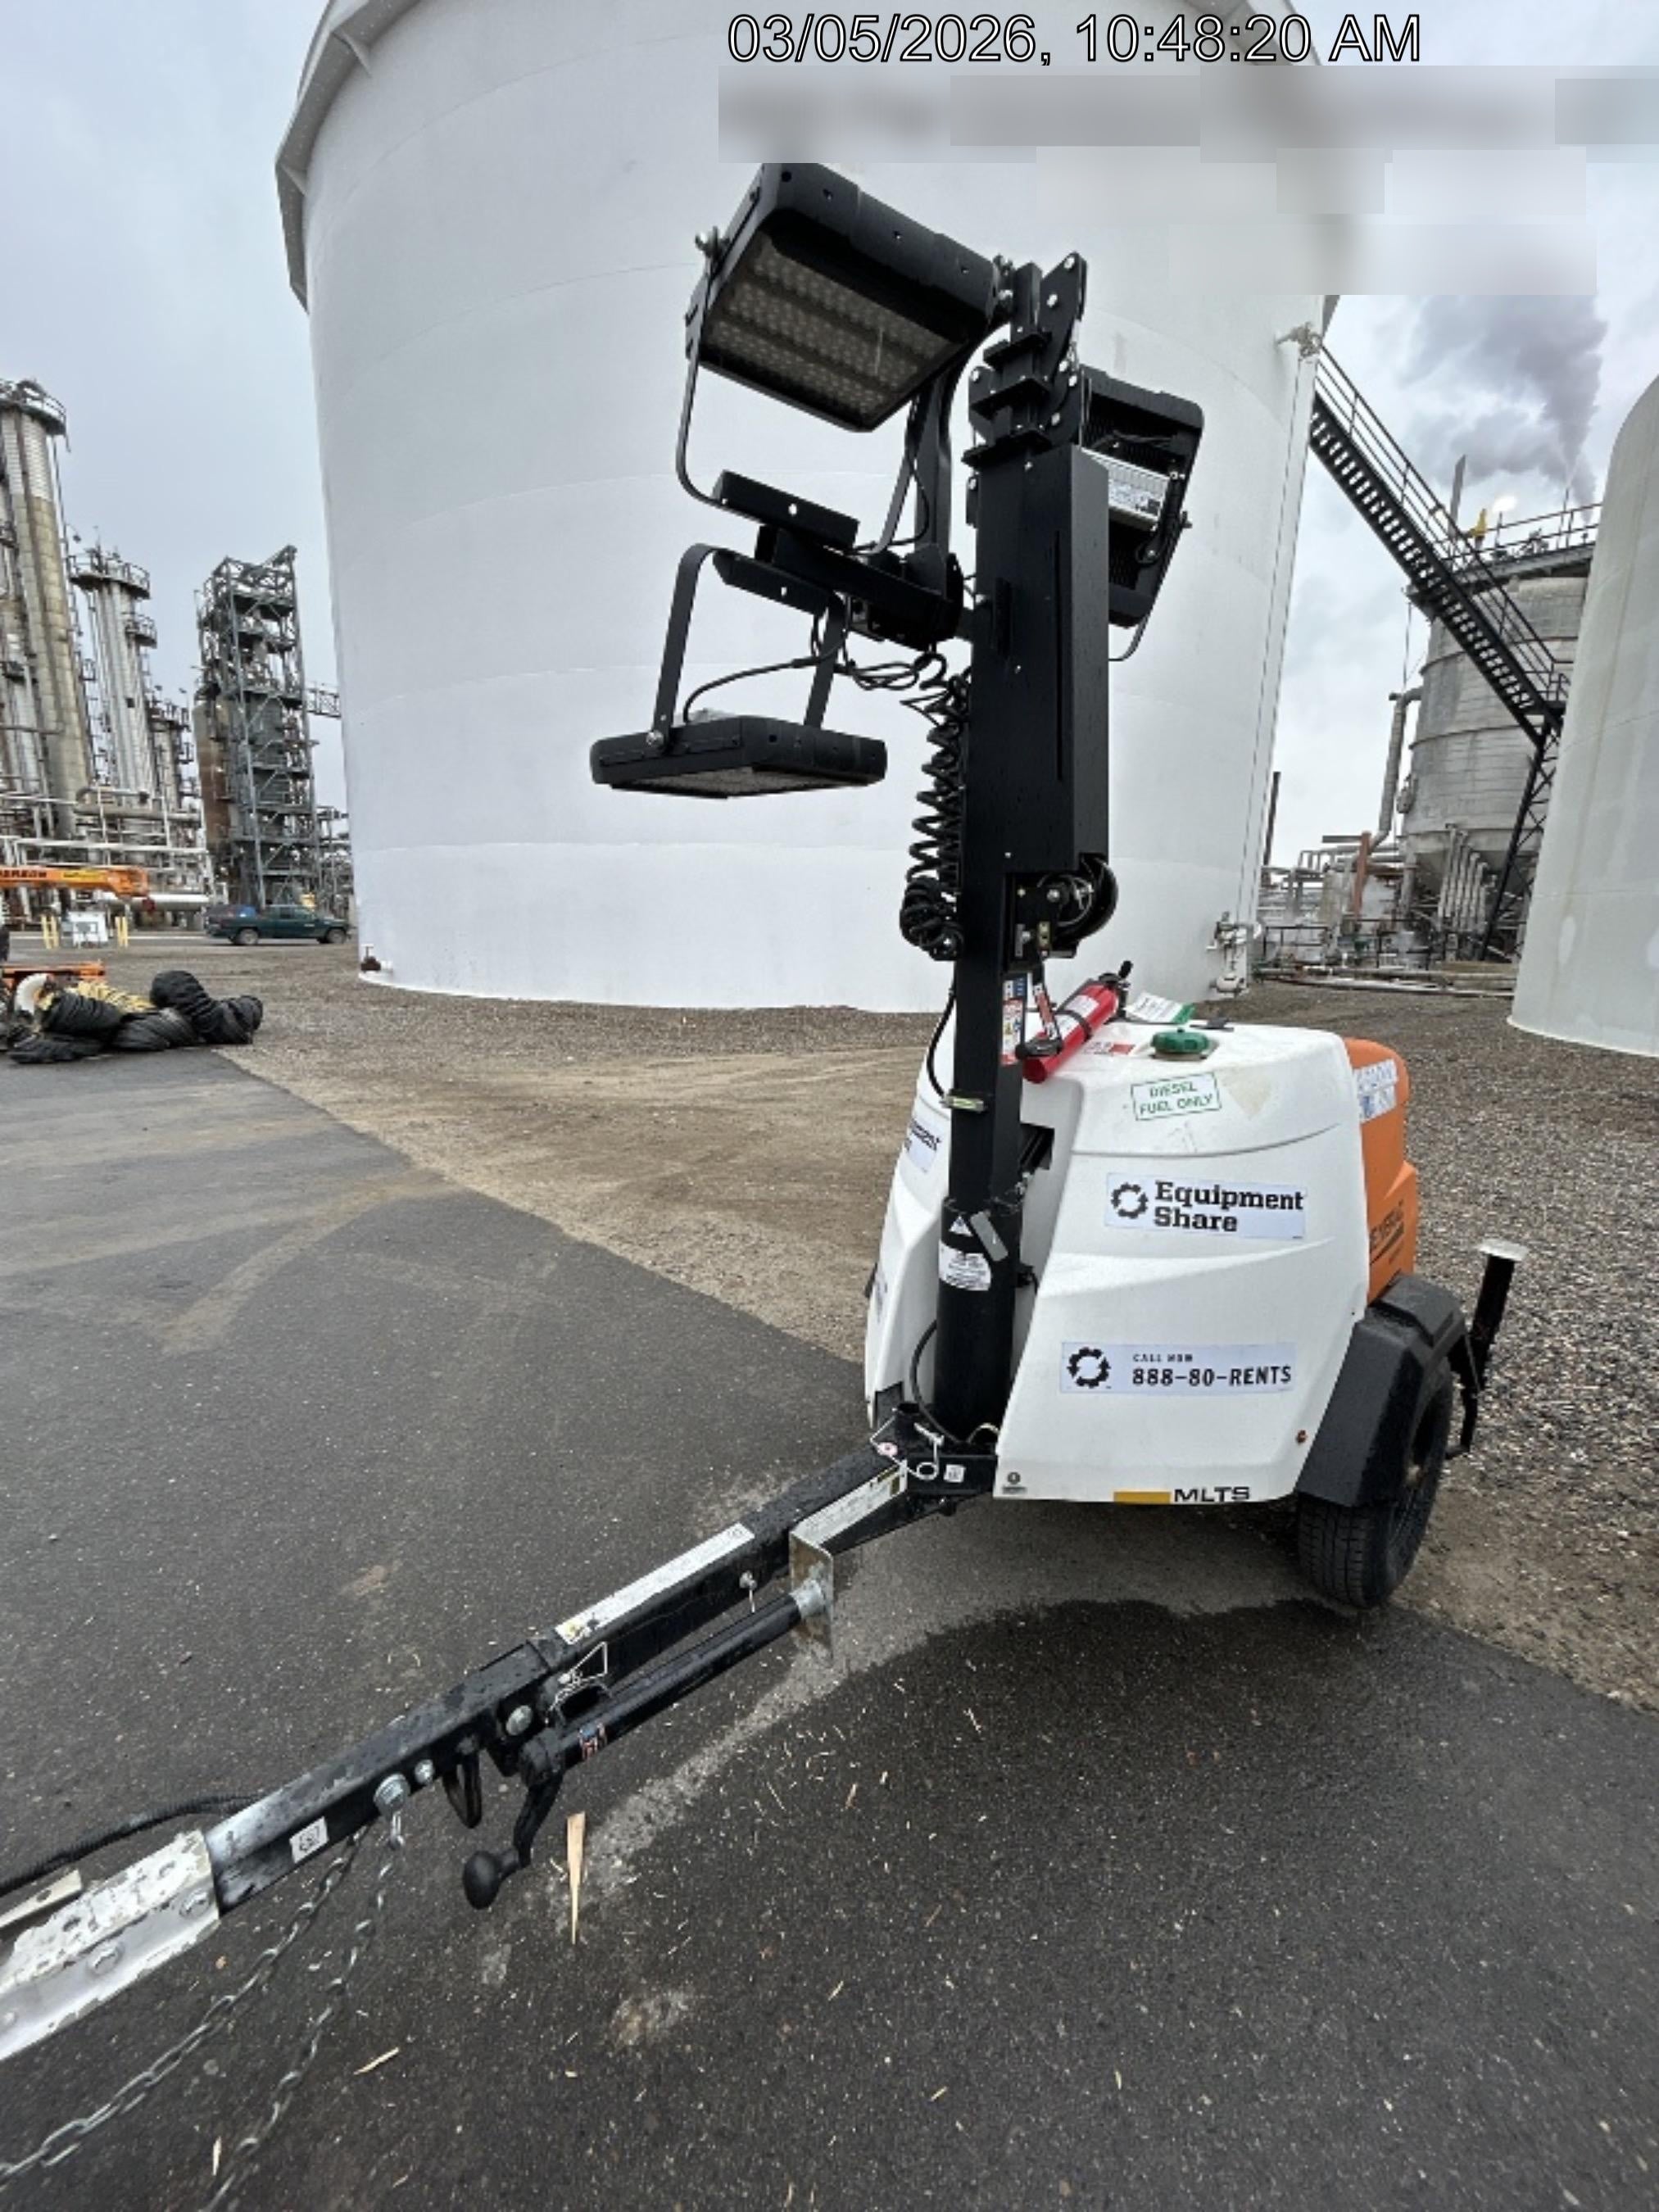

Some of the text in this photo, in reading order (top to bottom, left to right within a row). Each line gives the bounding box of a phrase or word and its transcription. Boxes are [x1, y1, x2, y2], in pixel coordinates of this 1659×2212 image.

[1149, 1081, 1199, 1099] DIESEL
[1140, 1094, 1213, 1115] FUEL ONLY
[1154, 1180, 1304, 1211] Equipment
[1154, 1206, 1238, 1232] Share
[1132, 1353, 1162, 1363] CALL
[1132, 1366, 1292, 1387] 888-80-RENTS
[1174, 1486, 1250, 1503] MLTS
